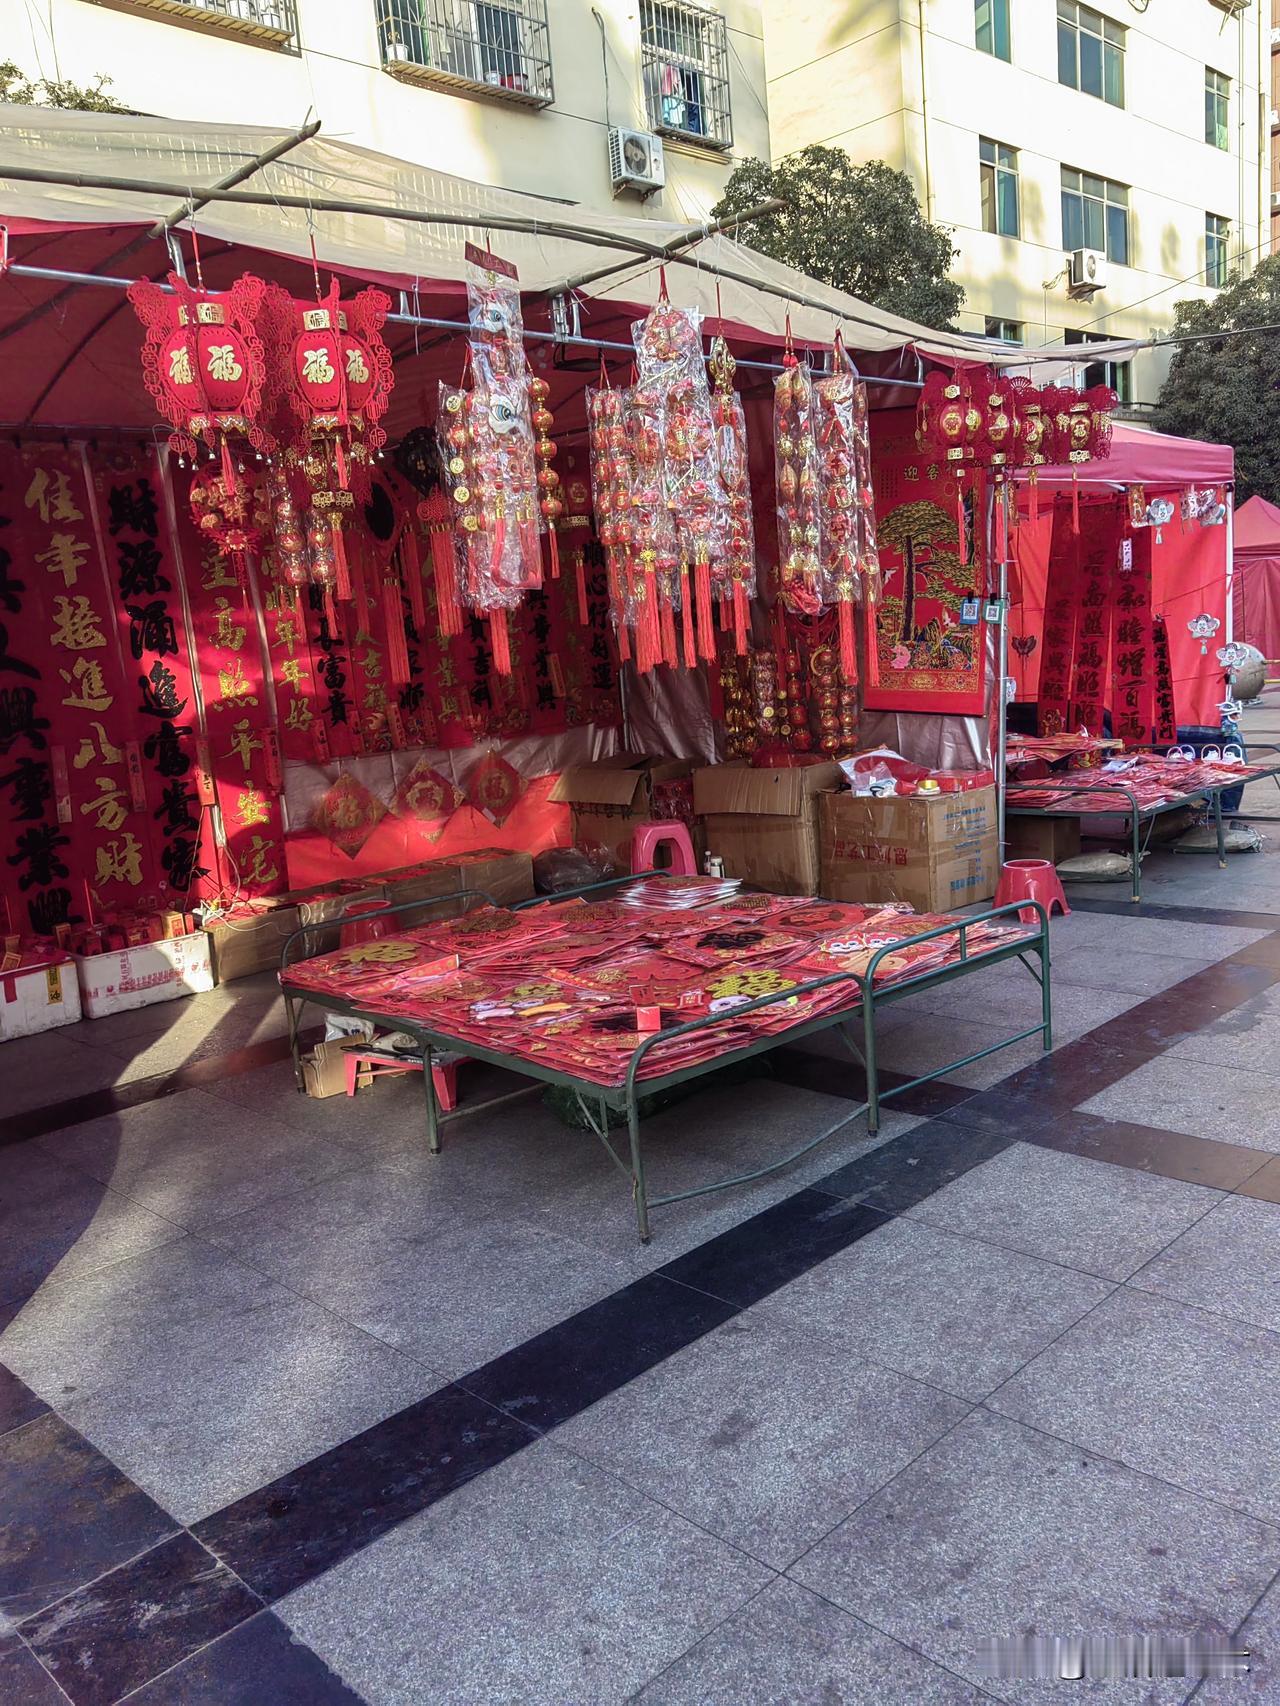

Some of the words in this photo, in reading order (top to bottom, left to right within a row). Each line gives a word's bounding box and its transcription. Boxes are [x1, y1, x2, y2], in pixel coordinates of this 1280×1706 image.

[207, 345, 243, 382] 福
[302, 348, 335, 384] 福
[345, 349, 369, 384] 福
